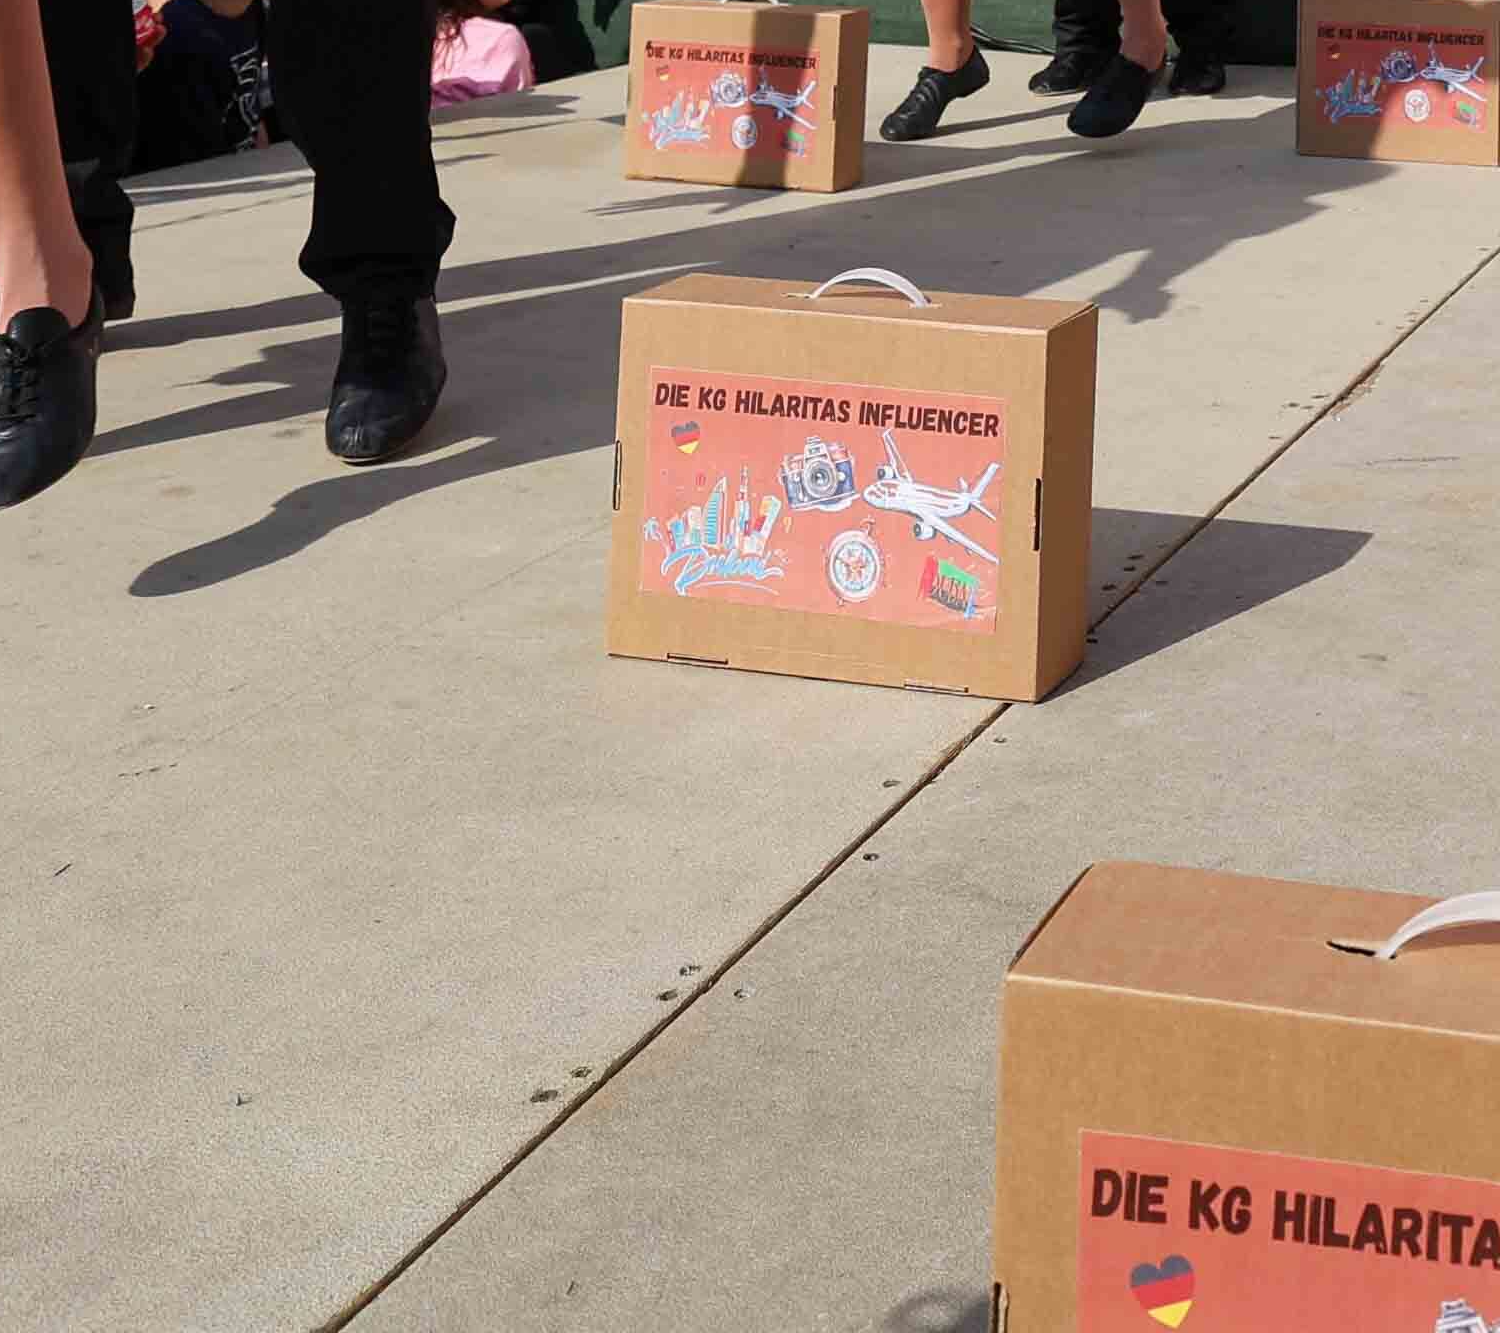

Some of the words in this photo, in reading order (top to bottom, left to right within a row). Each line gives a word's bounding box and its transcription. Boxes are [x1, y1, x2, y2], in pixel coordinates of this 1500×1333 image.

[687, 49, 744, 65] HILARITAS
[655, 383, 690, 408] DIE
[698, 386, 727, 412] KG
[735, 390, 851, 424] HILARITAS
[858, 400, 1001, 438] INFLUENCER
[1091, 1168, 1169, 1224] DIE
[1188, 1178, 1253, 1236] KG
